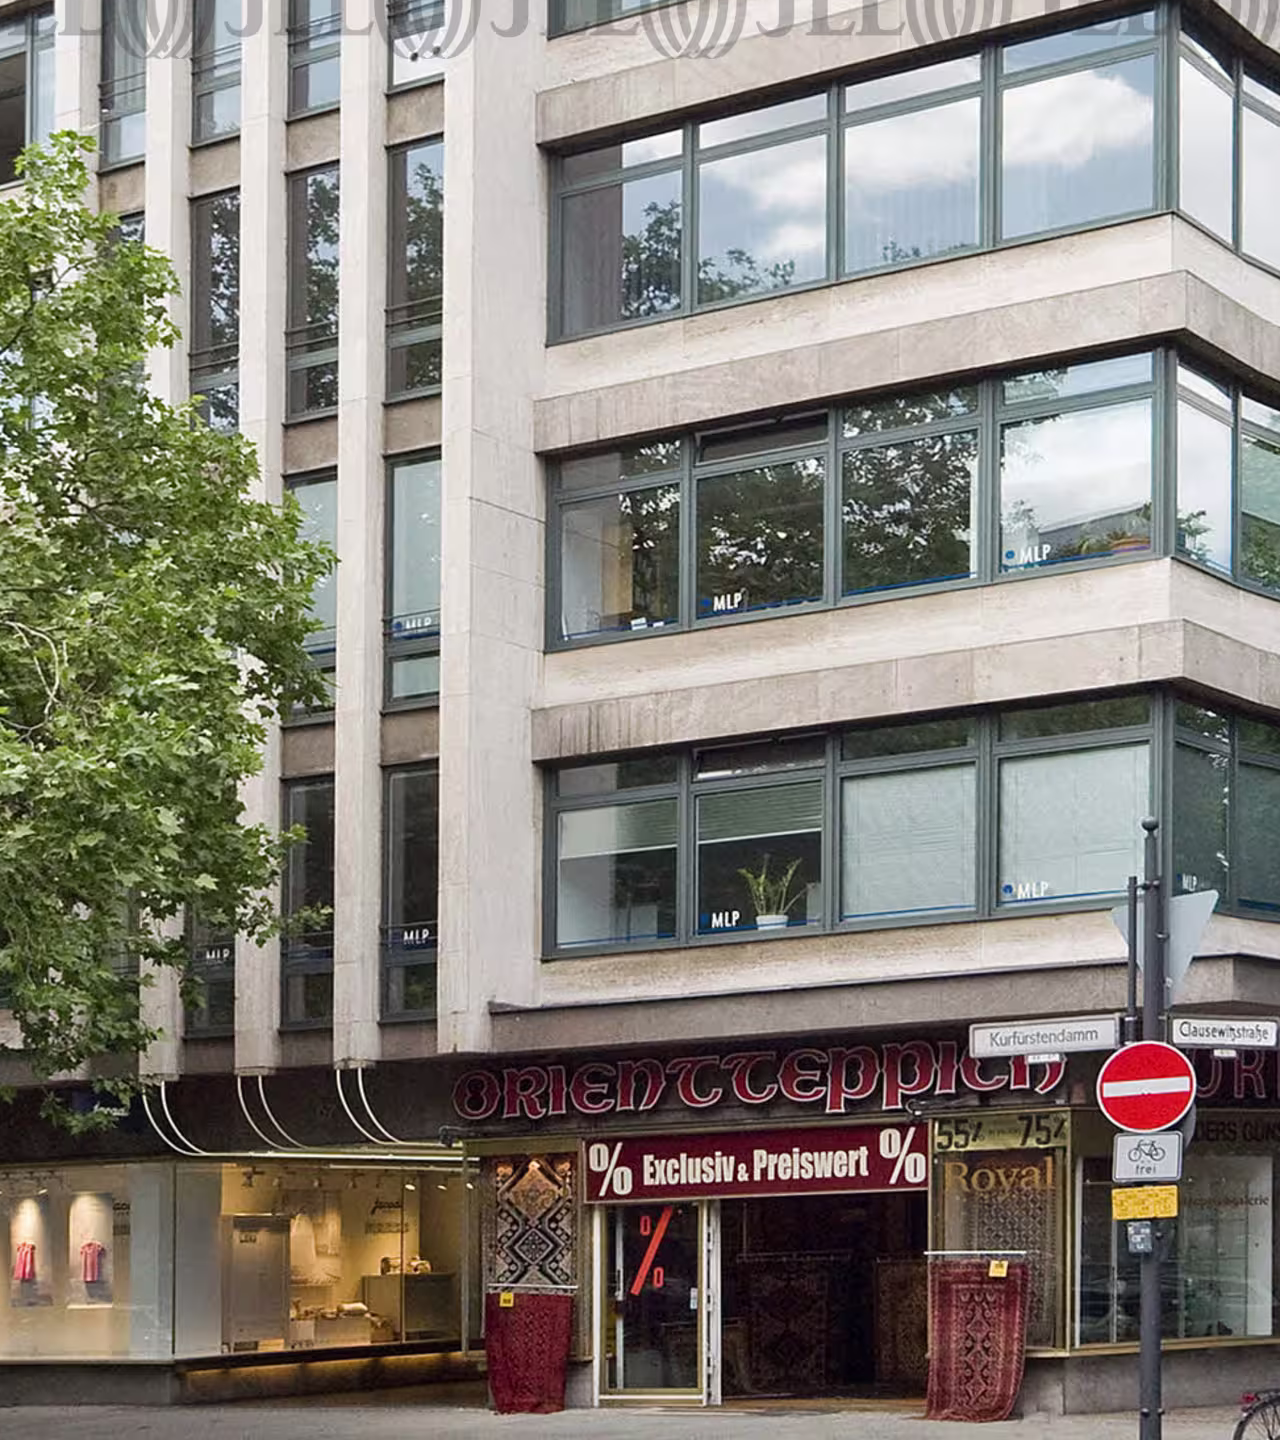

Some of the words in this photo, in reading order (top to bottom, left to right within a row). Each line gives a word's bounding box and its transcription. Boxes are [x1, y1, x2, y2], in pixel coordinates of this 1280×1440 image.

[1020, 544, 1051, 563] MLP
[713, 592, 743, 612] MLP
[1017, 881, 1049, 899] MLP
[712, 910, 740, 928] MLP
[403, 928, 429, 945] MLP
[989, 1027, 1099, 1048] Kurfürstendamm
[1179, 1020, 1269, 1042] Clausewitzstraße
[937, 1119, 985, 1150] 55%
[1017, 1113, 1068, 1147] 75%
[642, 1151, 735, 1187] Exclusiv
[737, 1162, 749, 1183] &
[753, 1145, 869, 1181] Preiswert
[1135, 1164, 1157, 1176] frei
[945, 1156, 1056, 1198] Royal
